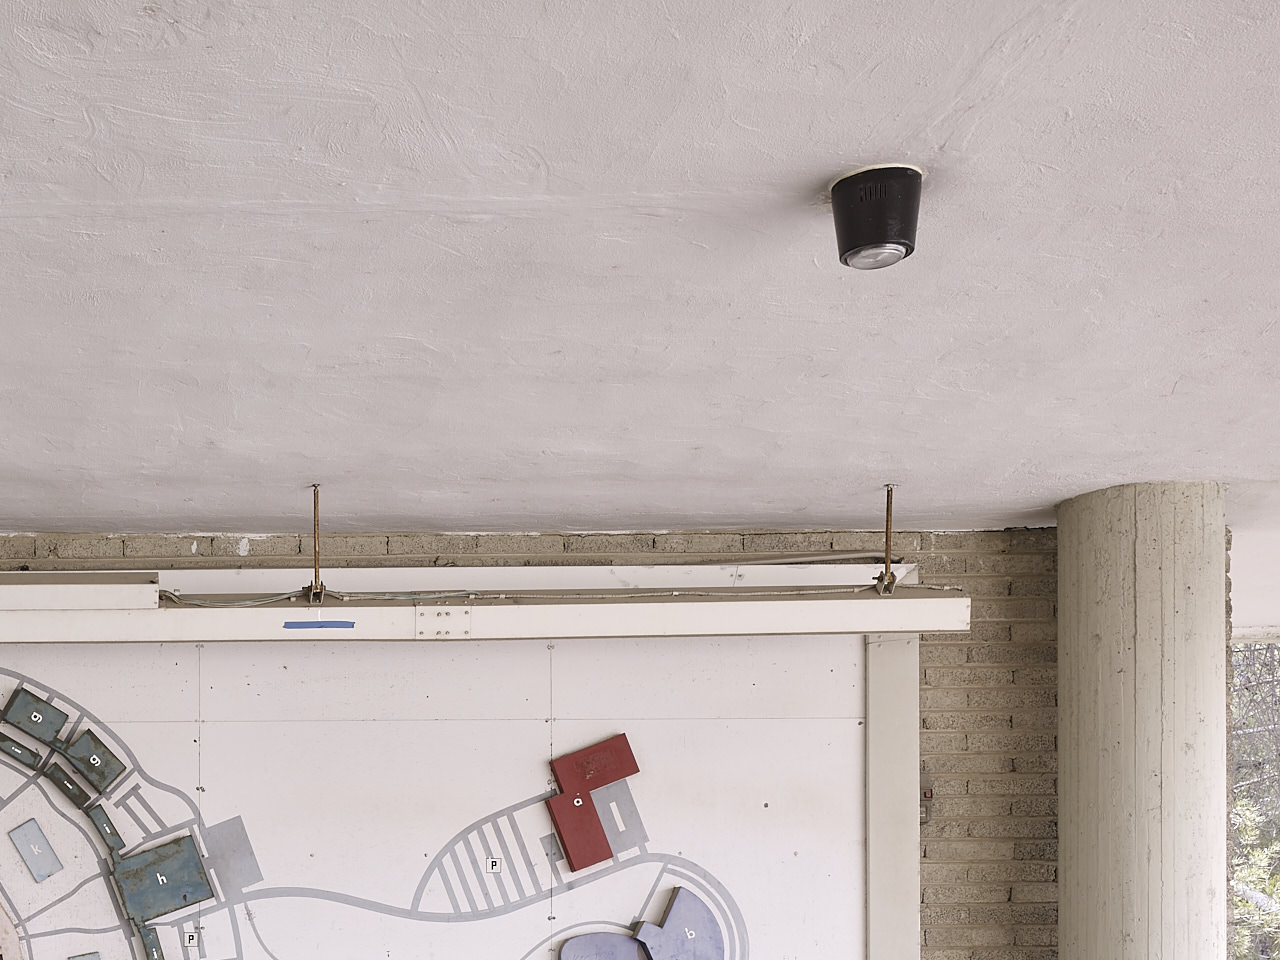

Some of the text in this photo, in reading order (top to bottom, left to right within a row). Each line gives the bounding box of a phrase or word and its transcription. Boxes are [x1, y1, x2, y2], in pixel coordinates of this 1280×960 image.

[573, 798, 583, 806] a
[30, 844, 42, 856] k
[491, 861, 497, 870] P
[157, 873, 167, 884] h
[188, 935, 194, 943] P
[684, 928, 696, 940] b
[153, 948, 157, 959] i
